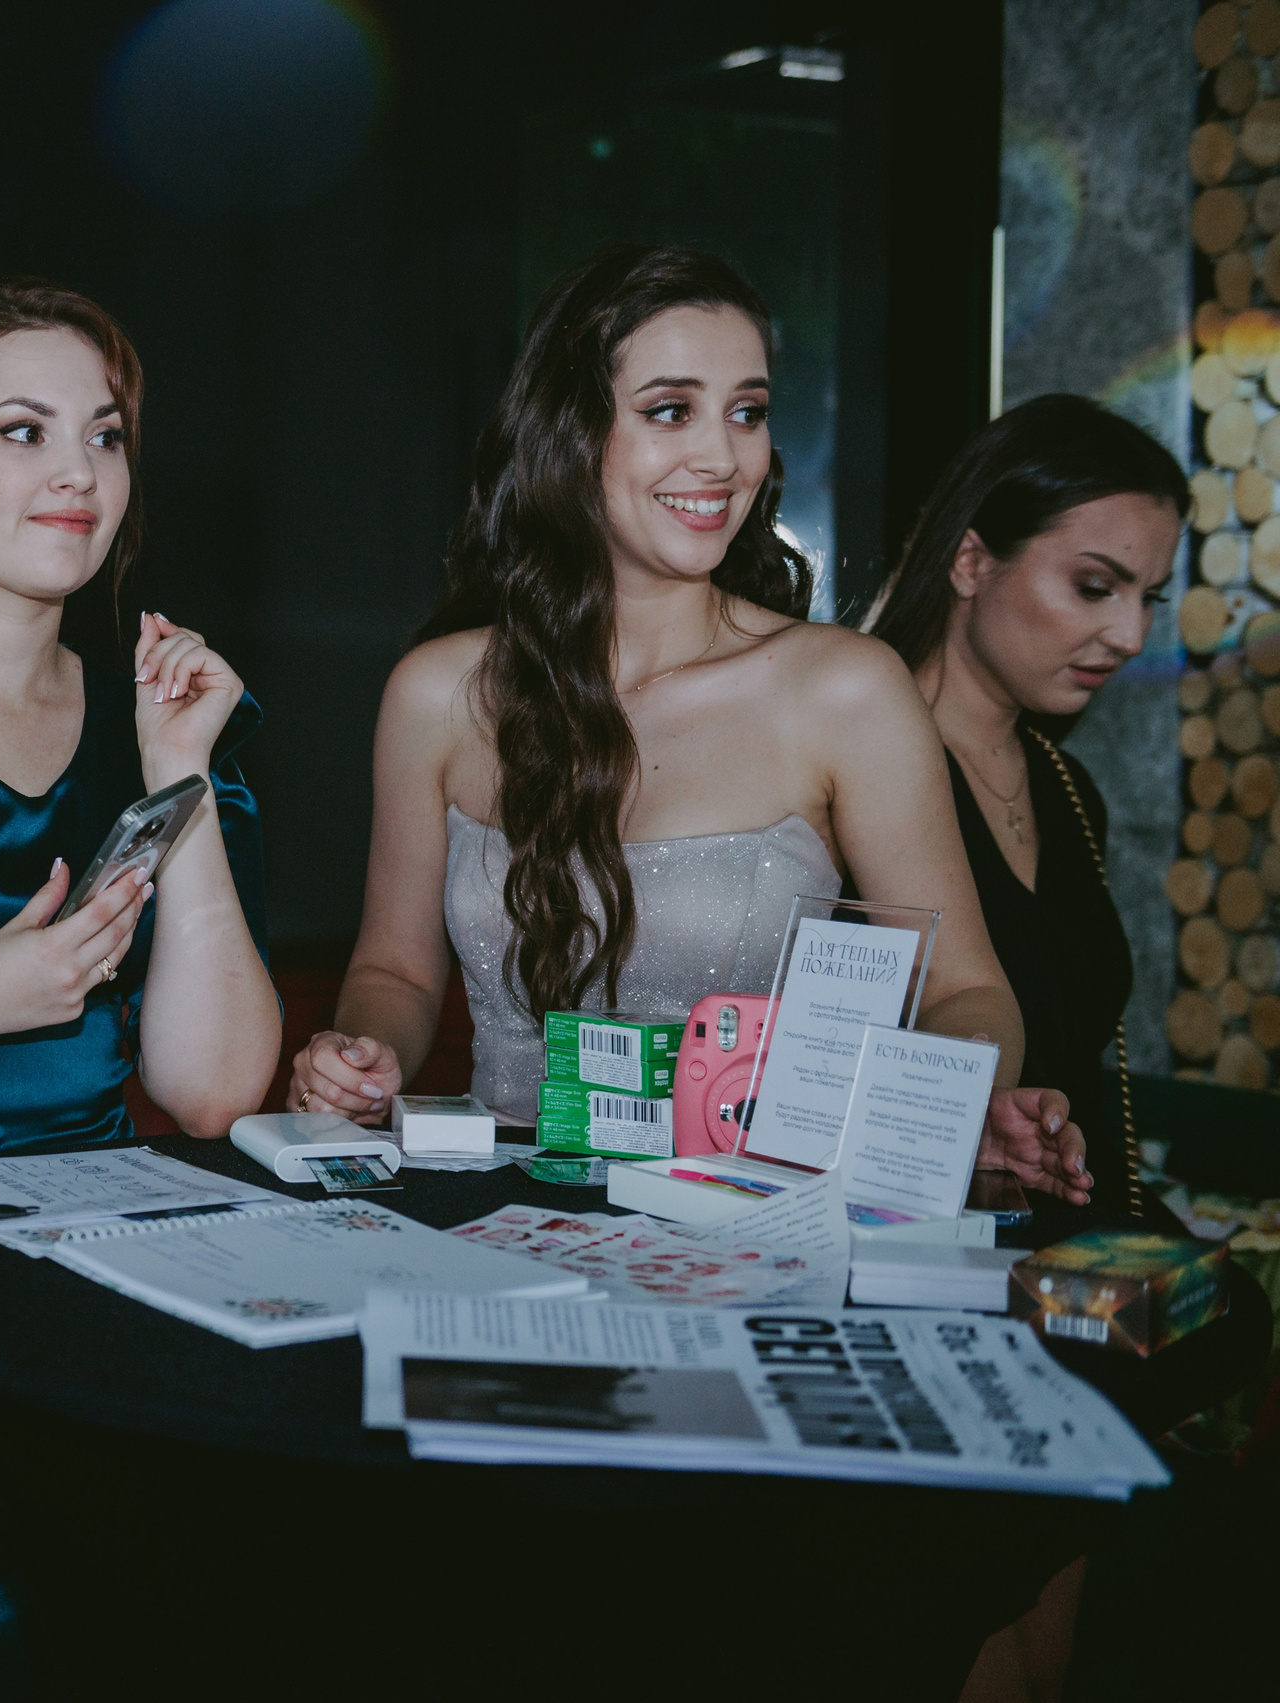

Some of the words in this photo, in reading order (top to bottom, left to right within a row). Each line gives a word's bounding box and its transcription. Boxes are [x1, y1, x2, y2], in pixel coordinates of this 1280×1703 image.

[804, 939, 835, 958] ДЛЯ
[837, 944, 901, 966] ТЕПЛЫХ
[799, 957, 898, 985] ПОЖЕЛАНИЙ
[874, 1043, 908, 1061] ЕСТЬ
[910, 1049, 981, 1074] ВОПРОСЫ?
[830, 1114, 845, 1123] улыб
